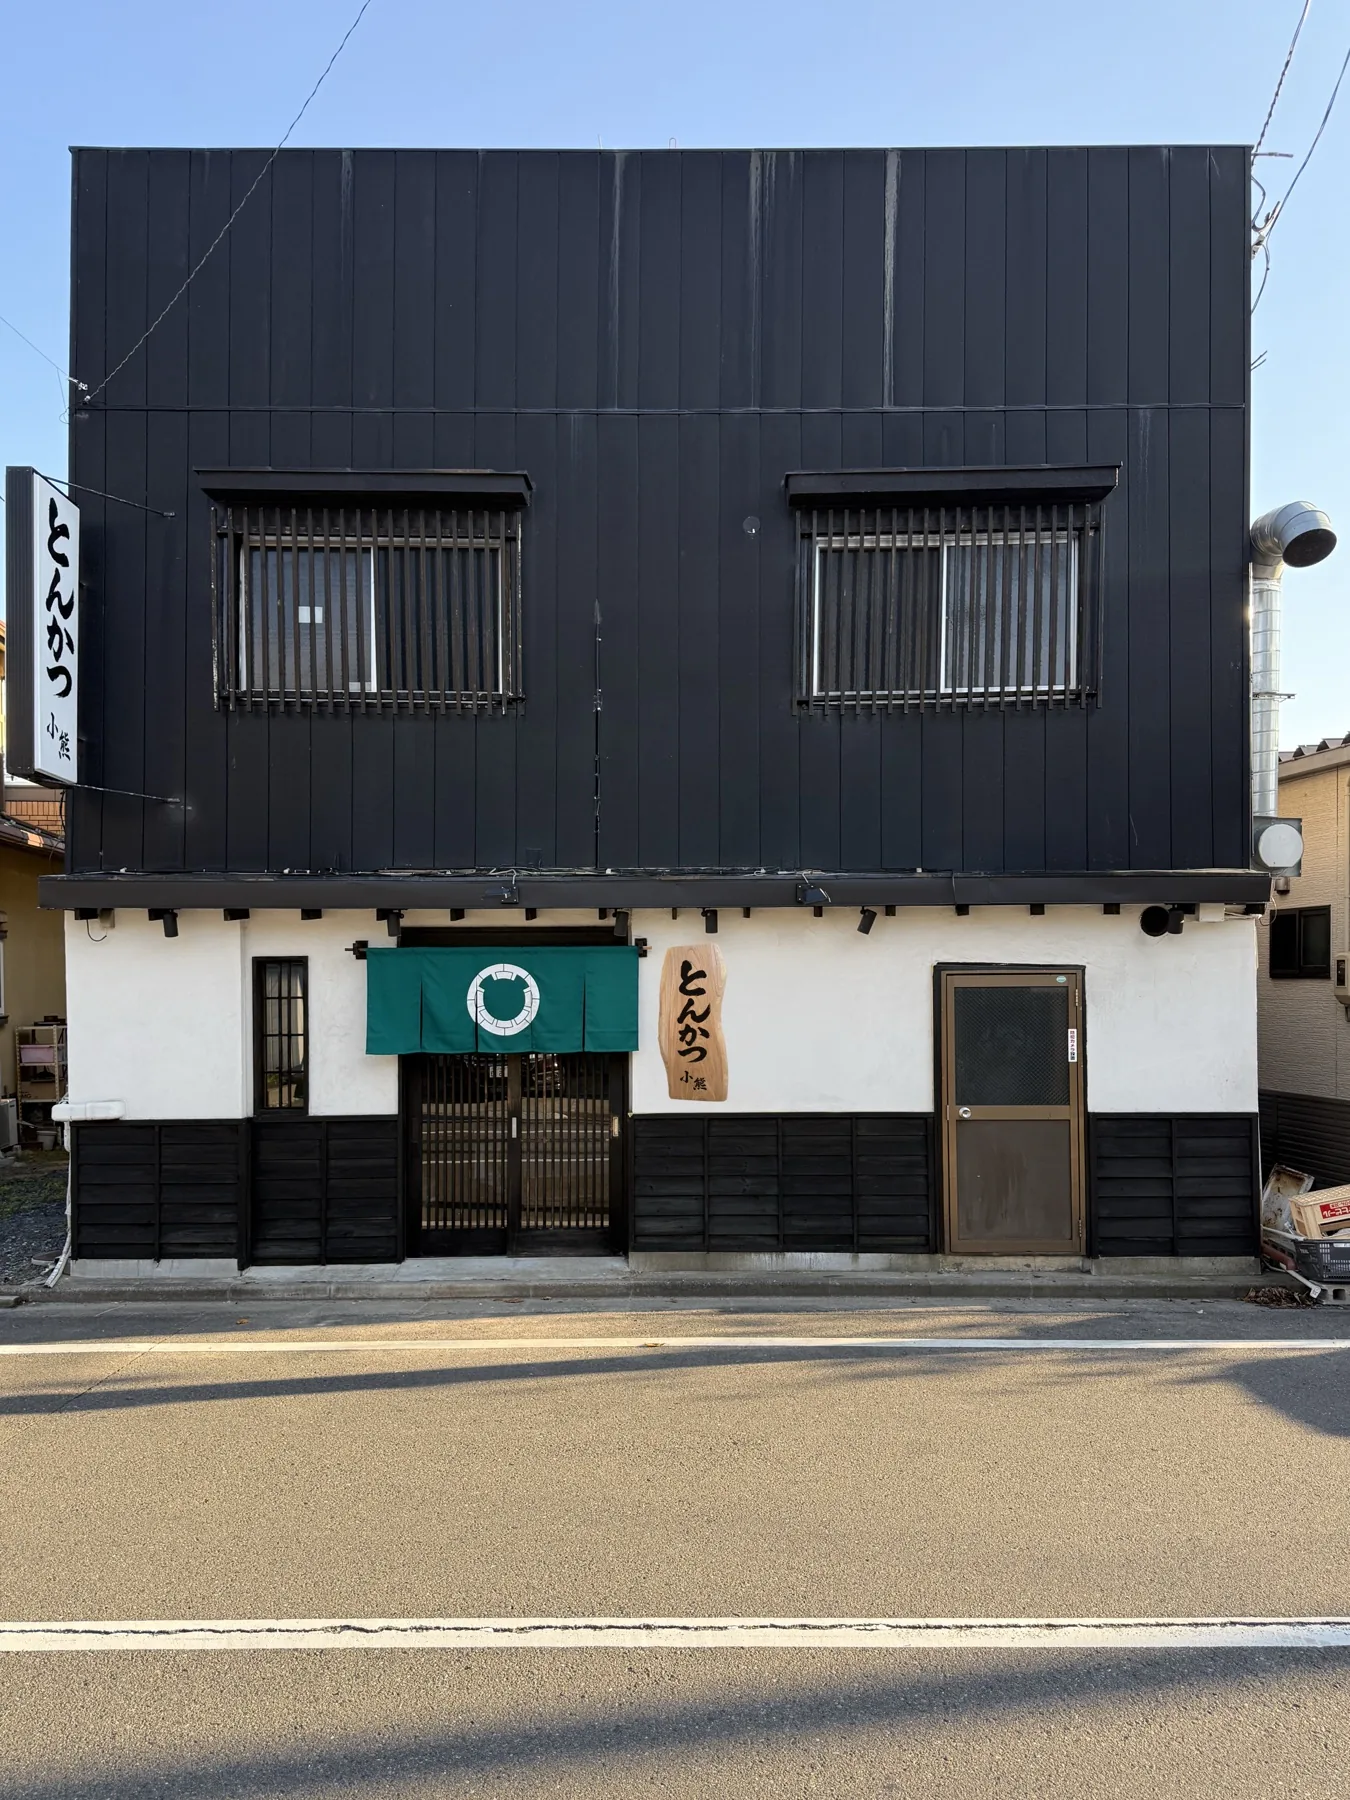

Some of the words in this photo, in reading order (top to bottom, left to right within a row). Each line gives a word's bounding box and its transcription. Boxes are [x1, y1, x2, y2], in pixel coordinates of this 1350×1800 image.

[45, 497, 75, 698] とんかつ
[46, 712, 71, 761] 小熊
[677, 960, 711, 1063] とんかつ
[680, 1071, 707, 1091] 小熊
[1323, 1206, 1350, 1218] ヒビール
